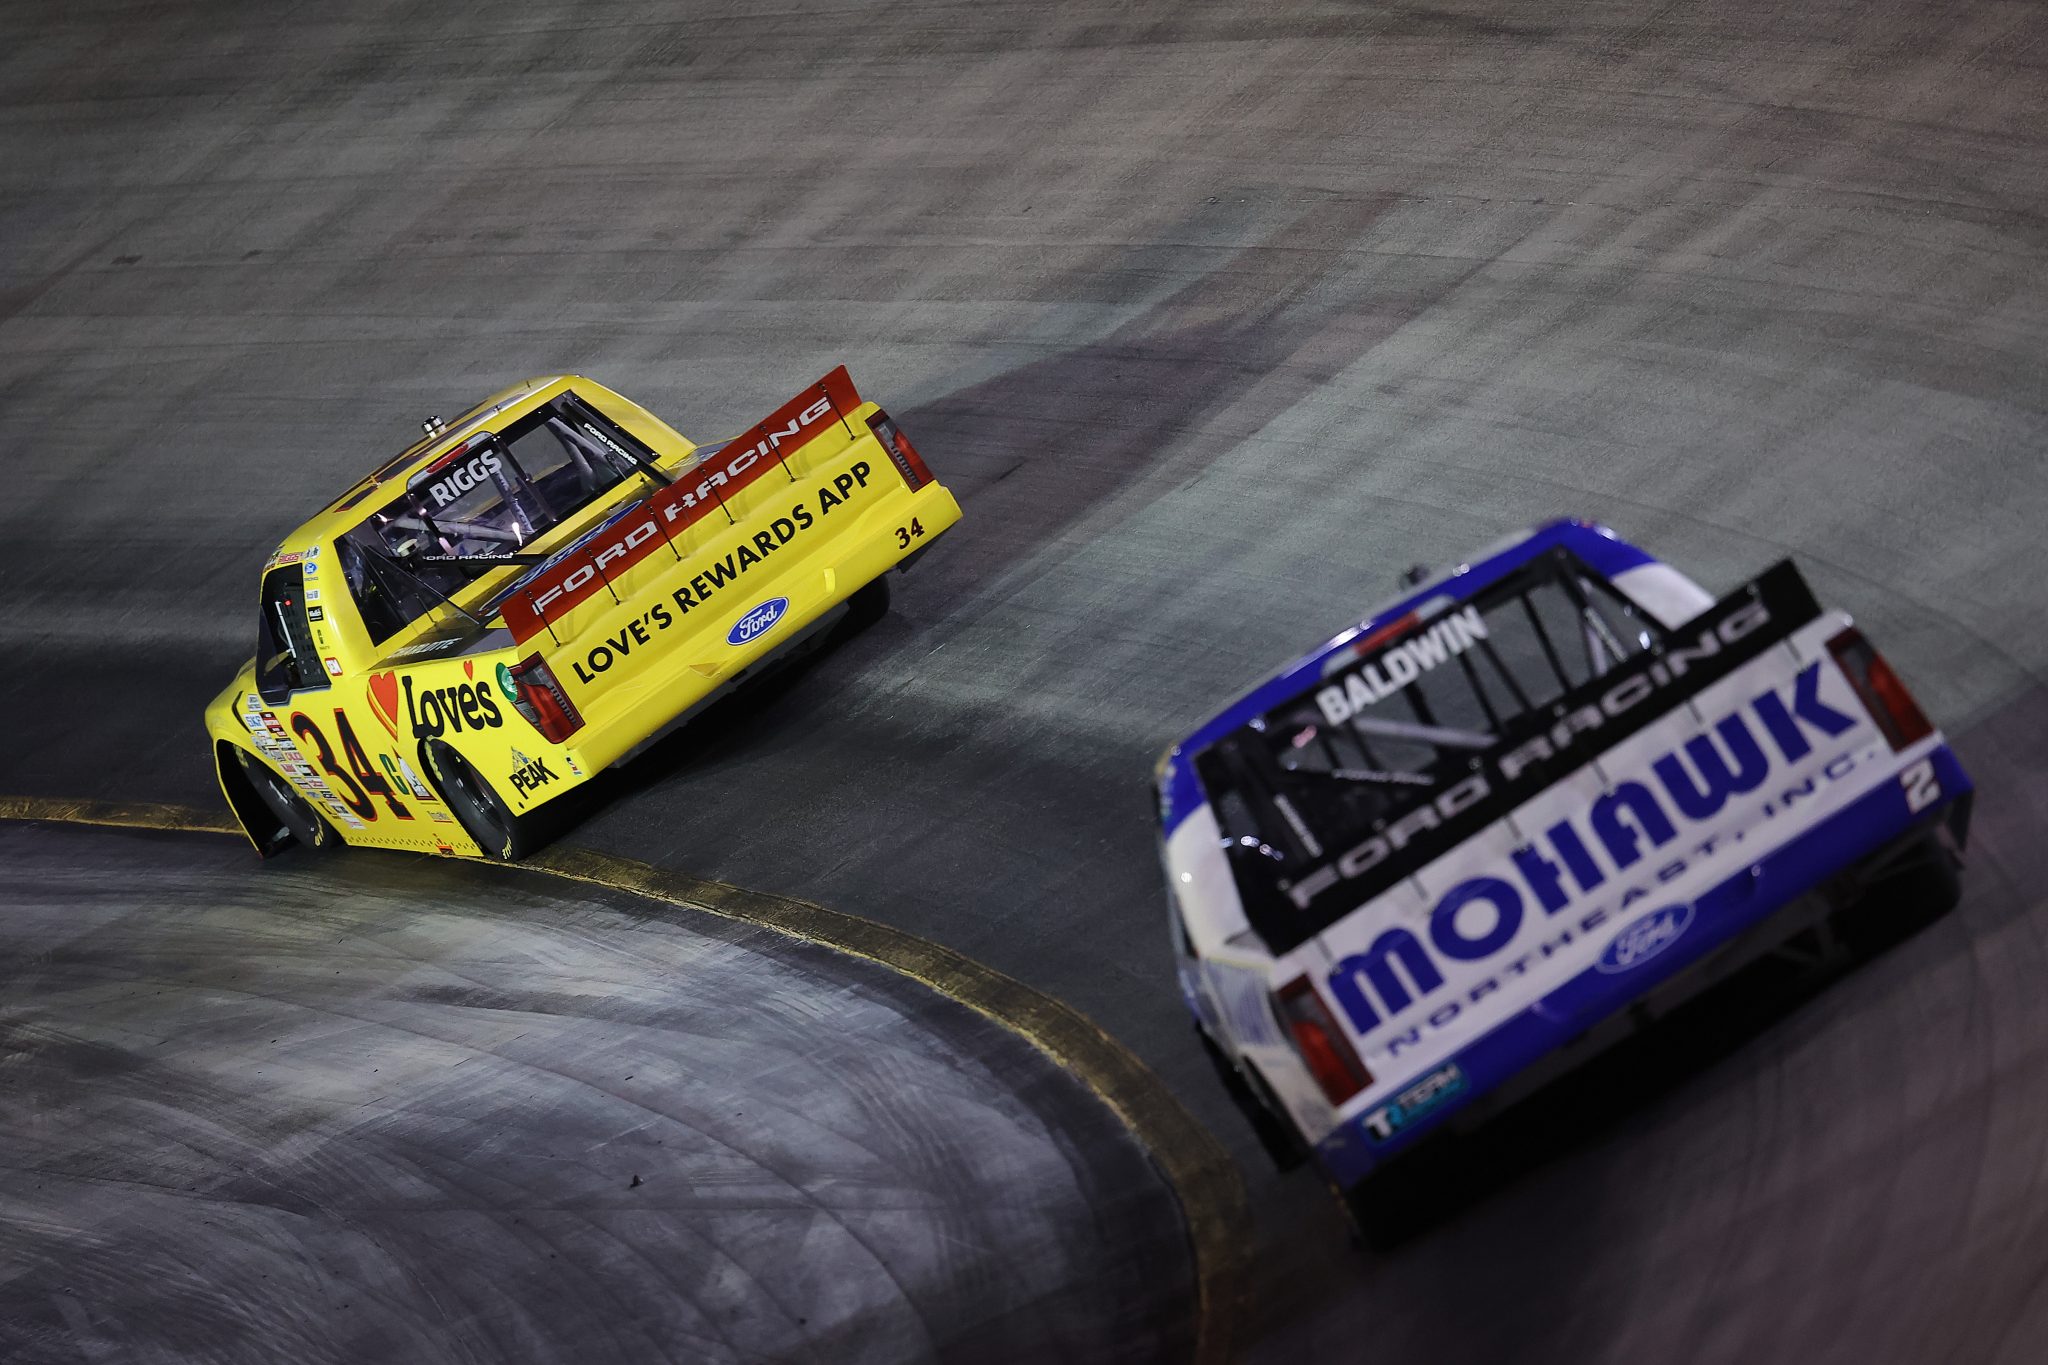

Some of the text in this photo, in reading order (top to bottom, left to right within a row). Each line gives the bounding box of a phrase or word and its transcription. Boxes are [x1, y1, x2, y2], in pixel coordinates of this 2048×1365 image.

[429, 449, 502, 507] RIGGS
[583, 422, 638, 466] FORD RACING
[531, 520, 658, 616] FORD
[663, 396, 832, 522] RACING
[895, 516, 925, 550] 34
[572, 460, 872, 684] LOVE'S REWARDS APP
[1314, 604, 1489, 727] BALDWIN
[290, 707, 414, 822] 34
[508, 757, 560, 800] PEAK
[1287, 599, 1772, 911] FORD RACING
[1763, 749, 1876, 819] INC.
[1900, 757, 1942, 814] 2
[1326, 658, 1858, 1036] MOHAWK
